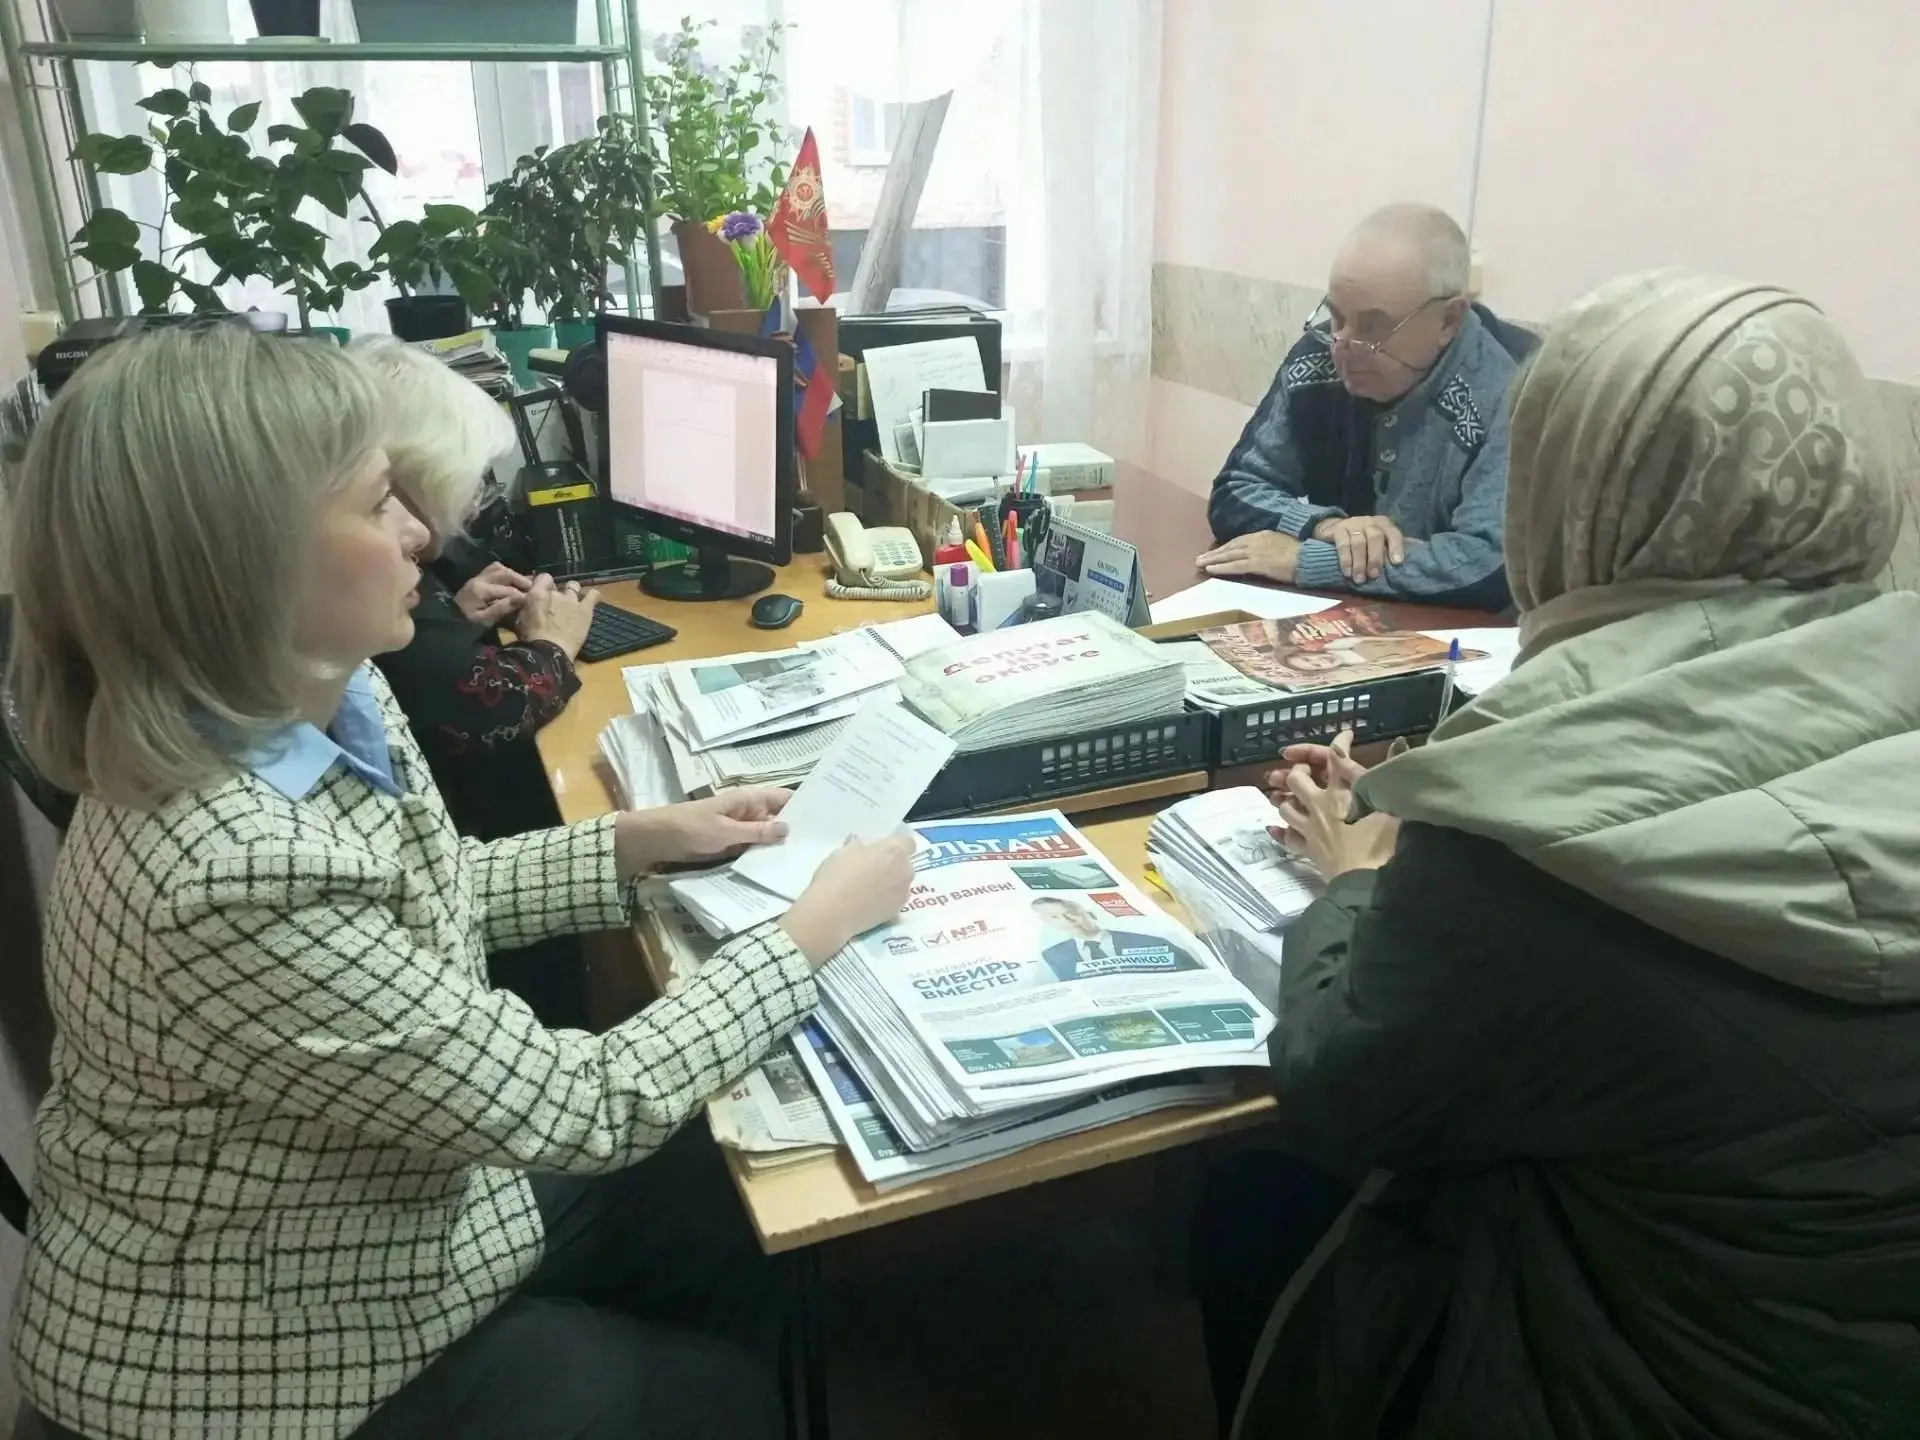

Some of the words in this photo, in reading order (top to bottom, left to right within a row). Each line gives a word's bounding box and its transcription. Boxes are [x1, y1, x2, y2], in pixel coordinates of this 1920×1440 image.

[975, 650, 1101, 684] округе
[930, 834, 1070, 859] ЛЬТАТ!
[899, 894, 949, 913] ыбор
[949, 881, 1016, 901] важен!
[912, 960, 1021, 989] СИБИРЬ
[1082, 955, 1171, 969] ТРАВНИКОВ
[920, 972, 1018, 1000] ВМЕСТЕ!
